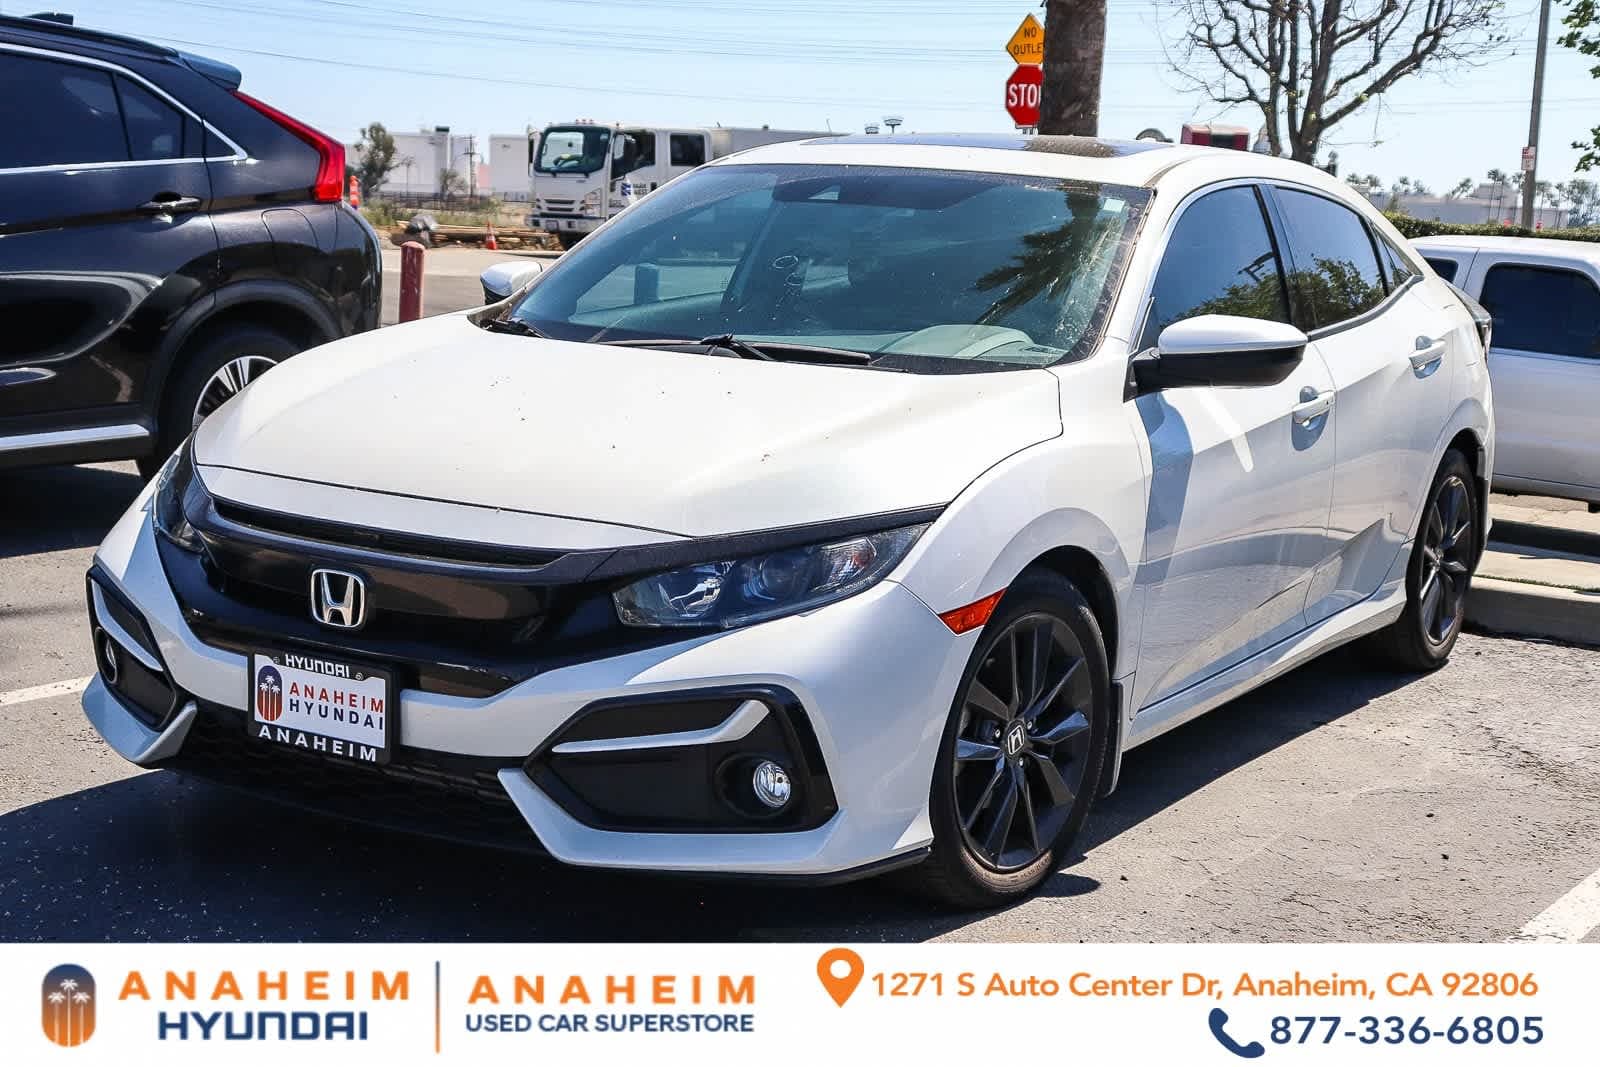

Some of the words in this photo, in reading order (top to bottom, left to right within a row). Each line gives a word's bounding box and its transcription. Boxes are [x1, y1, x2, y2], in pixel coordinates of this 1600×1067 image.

[1024, 27, 1037, 38] NO
[1013, 42, 1044, 55] OUTLE
[1008, 83, 1041, 107] STO
[285, 653, 350, 678] HYUNDAI
[289, 682, 384, 714] ANAHEIM
[289, 698, 384, 730] HYUNDAI
[258, 724, 377, 763] ANAHEIM
